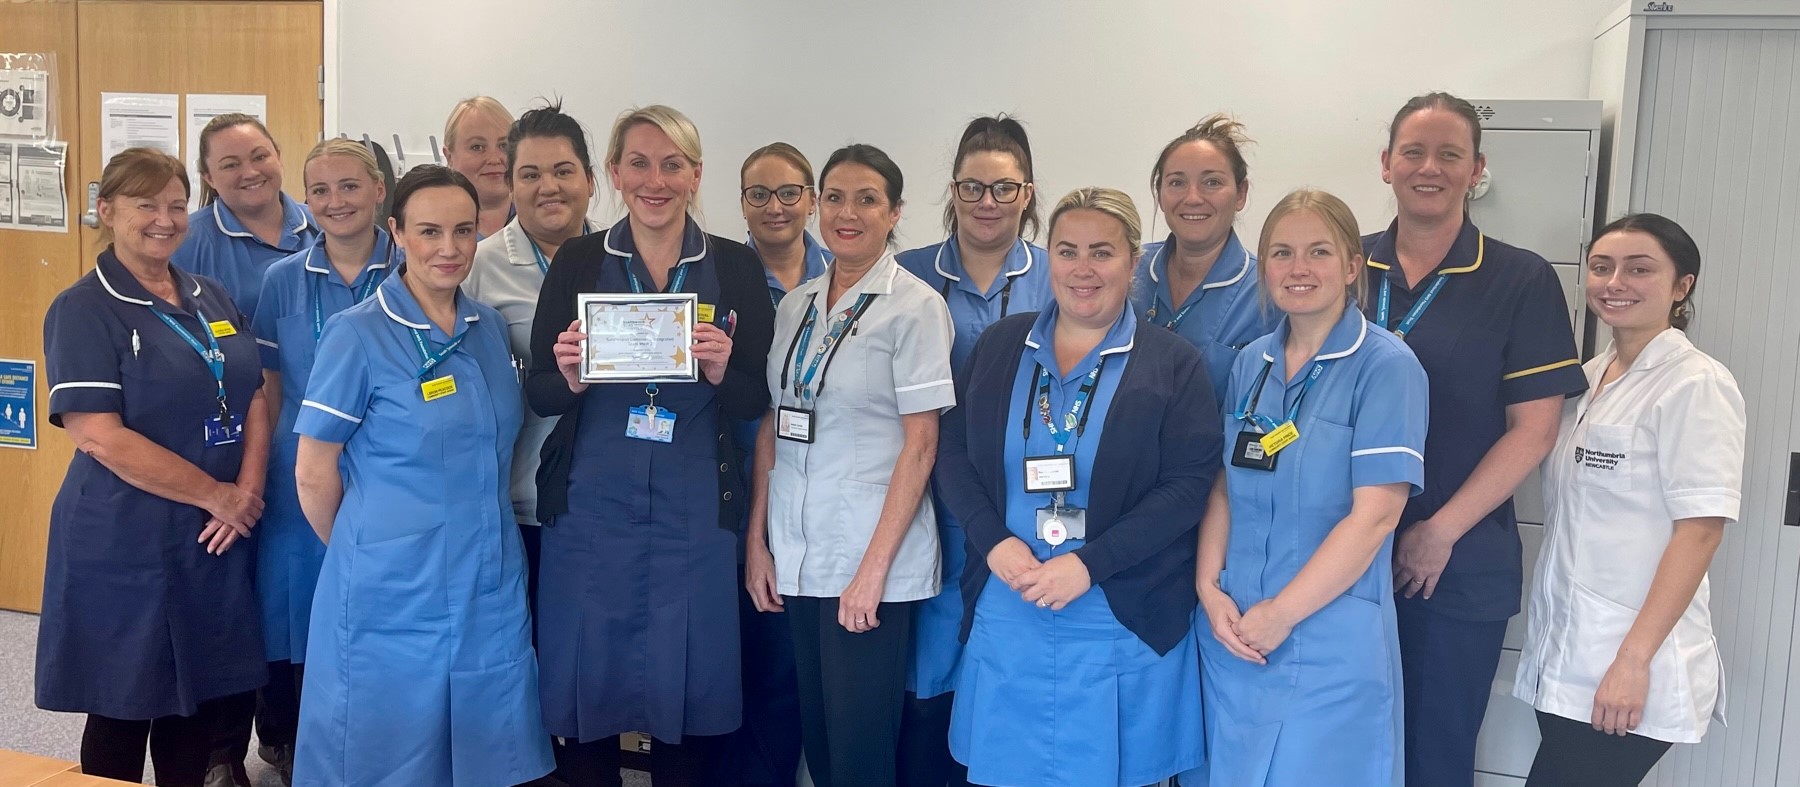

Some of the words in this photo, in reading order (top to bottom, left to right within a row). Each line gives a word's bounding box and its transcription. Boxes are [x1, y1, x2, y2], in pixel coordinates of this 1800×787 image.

[1089, 367, 1099, 379] NHS
[1071, 400, 1082, 414] NHS
[1585, 449, 1626, 459] Northumbria
[1585, 456, 1618, 466] University
